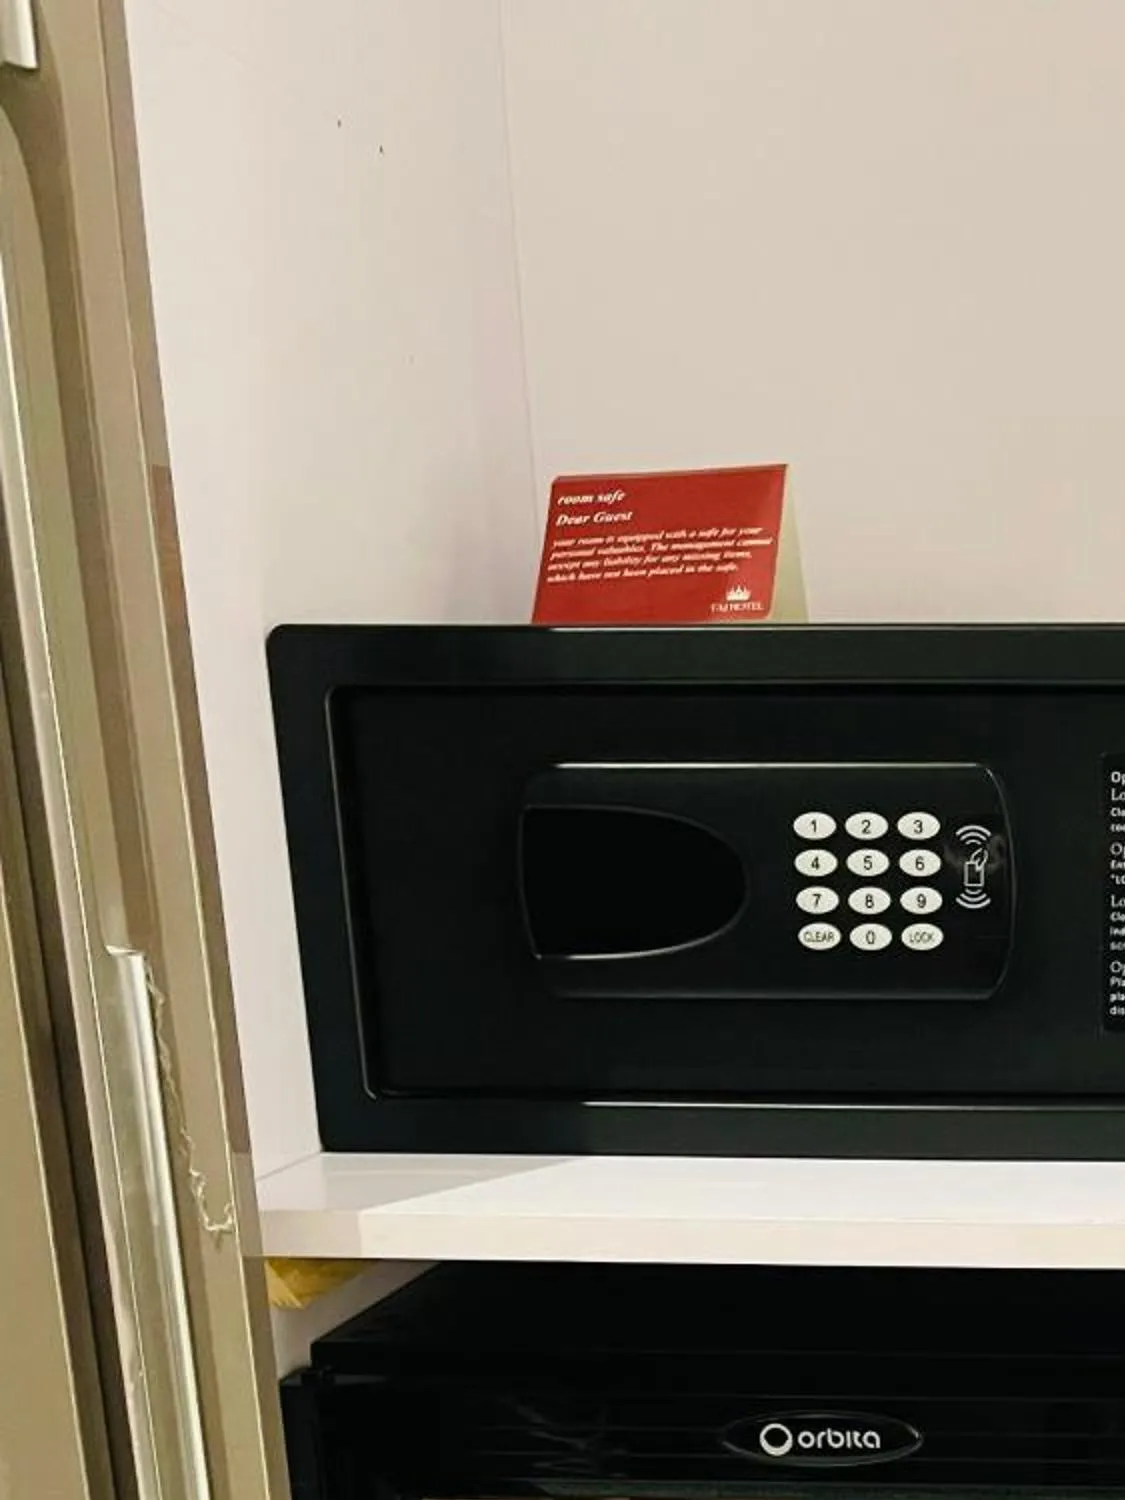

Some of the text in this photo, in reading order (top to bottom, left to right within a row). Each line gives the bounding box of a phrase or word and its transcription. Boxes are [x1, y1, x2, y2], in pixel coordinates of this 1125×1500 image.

[557, 489, 627, 506] room safe
[555, 511, 633, 527] Dear Guest
[811, 820, 923, 833] 1 2 3
[811, 856, 924, 870] 4 5 6
[812, 894, 926, 908] 7 8 9
[804, 931, 934, 945] CLEAR 0 LOCK
[797, 1428, 881, 1449] orbita
